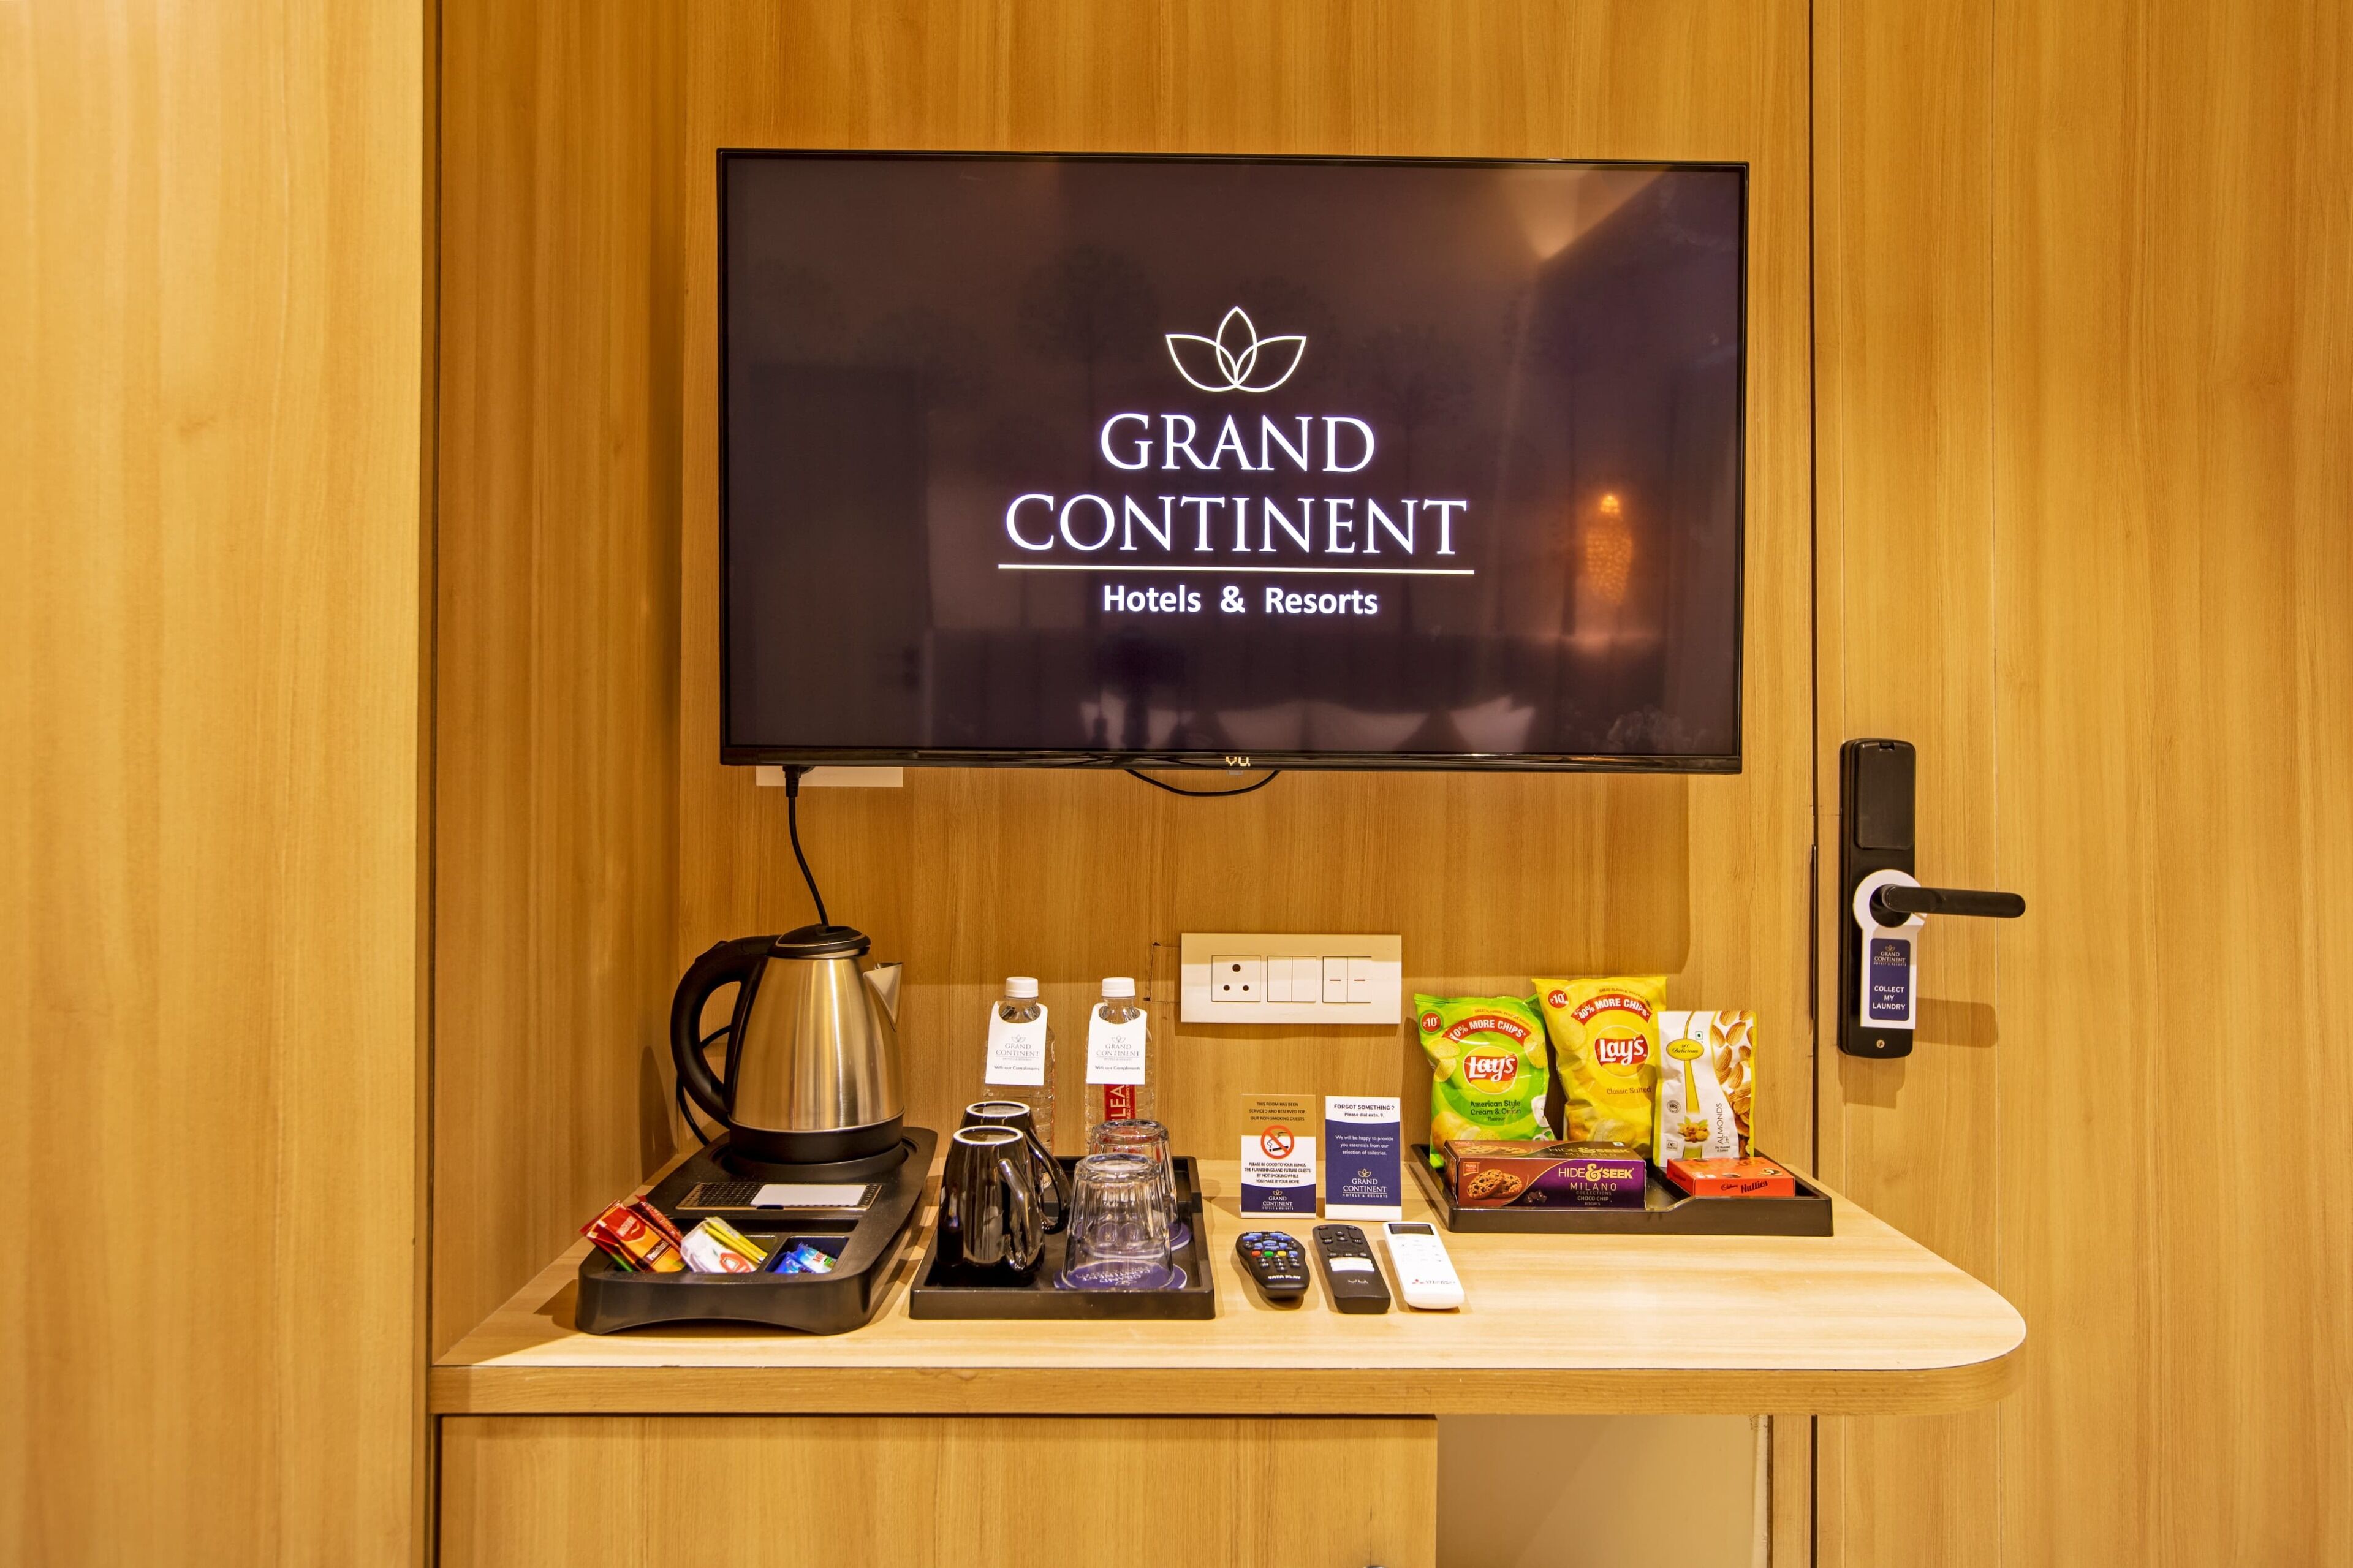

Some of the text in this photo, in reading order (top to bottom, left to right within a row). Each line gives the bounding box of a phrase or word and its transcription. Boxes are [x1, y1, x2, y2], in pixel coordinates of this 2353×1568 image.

[1101, 413, 1376, 473] GRAND
[1005, 494, 1468, 555] CONTINENT
[1104, 585, 1379, 615] Hotels & Resorts
[1578, 1004, 1595, 1020] 40%
[1595, 998, 1621, 1010] MORE
[1469, 1019, 1495, 1029] MORE
[1600, 1037, 1645, 1066] Lay's
[1469, 1055, 1515, 1083] Lay's
[1570, 1182, 1616, 1191] MILANO
[1740, 1180, 1768, 1194] Nutties
